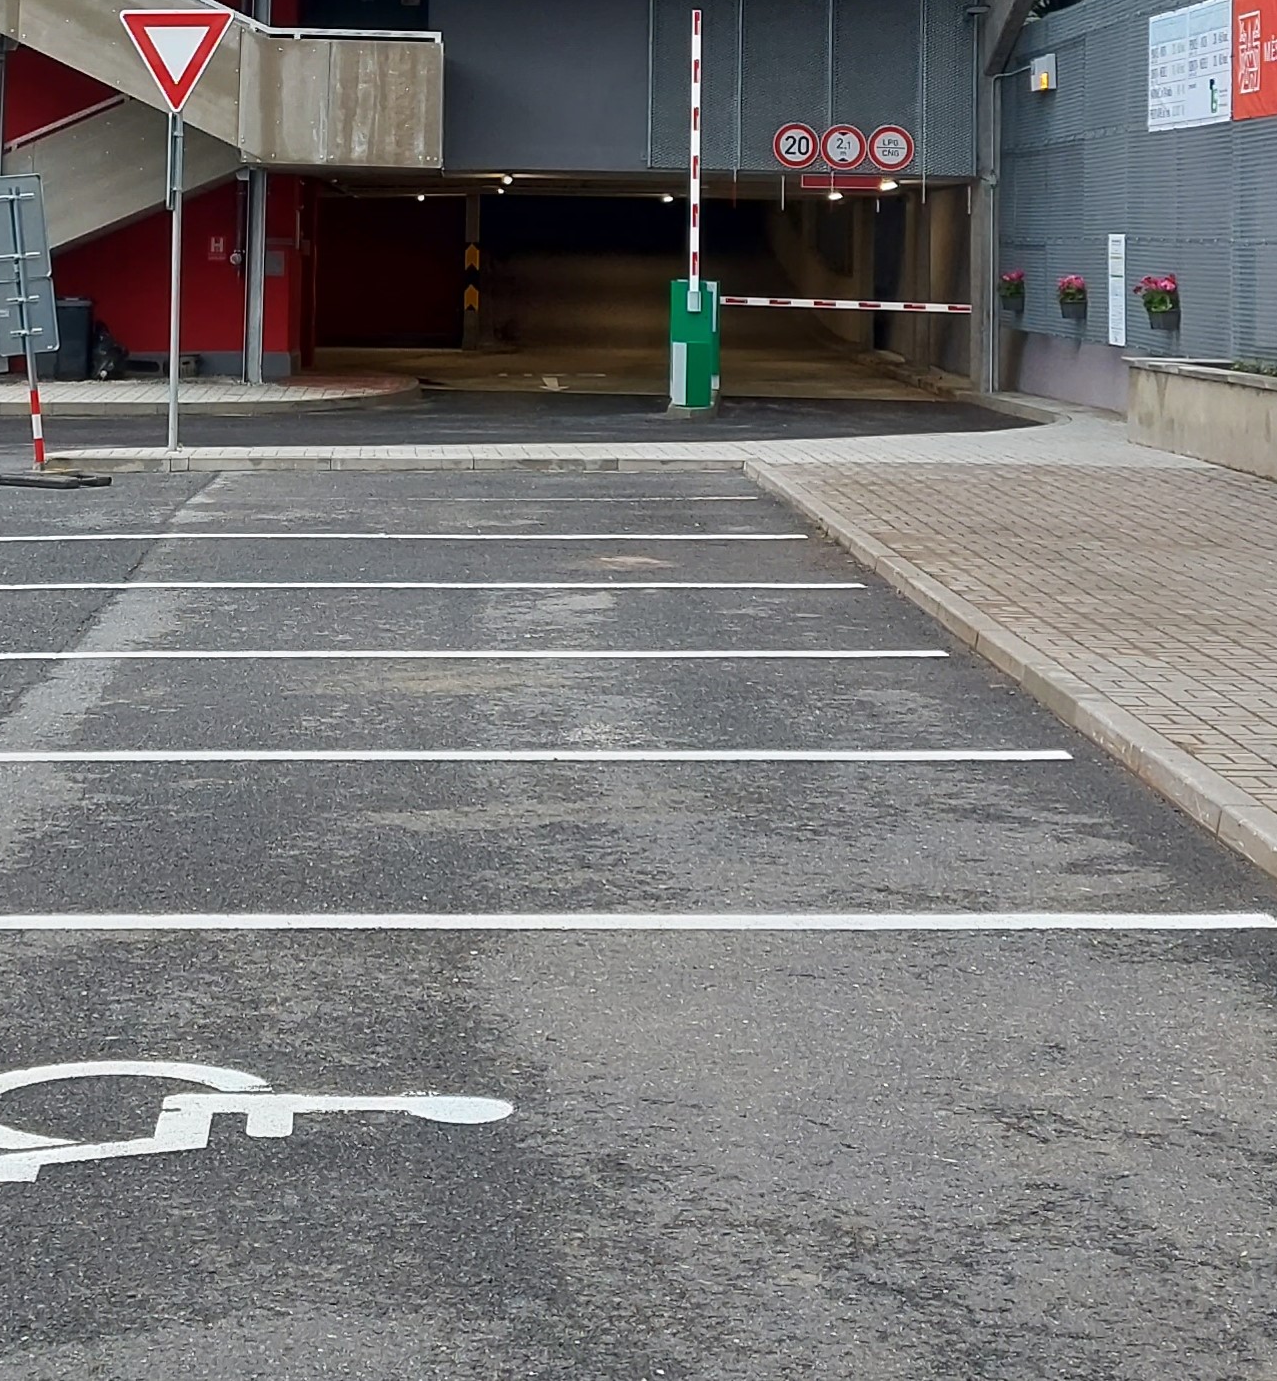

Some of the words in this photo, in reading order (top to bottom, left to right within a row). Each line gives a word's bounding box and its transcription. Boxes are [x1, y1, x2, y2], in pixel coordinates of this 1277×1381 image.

[784, 135, 810, 155] 20
[881, 149, 899, 157] CNG
[210, 237, 224, 252] H
